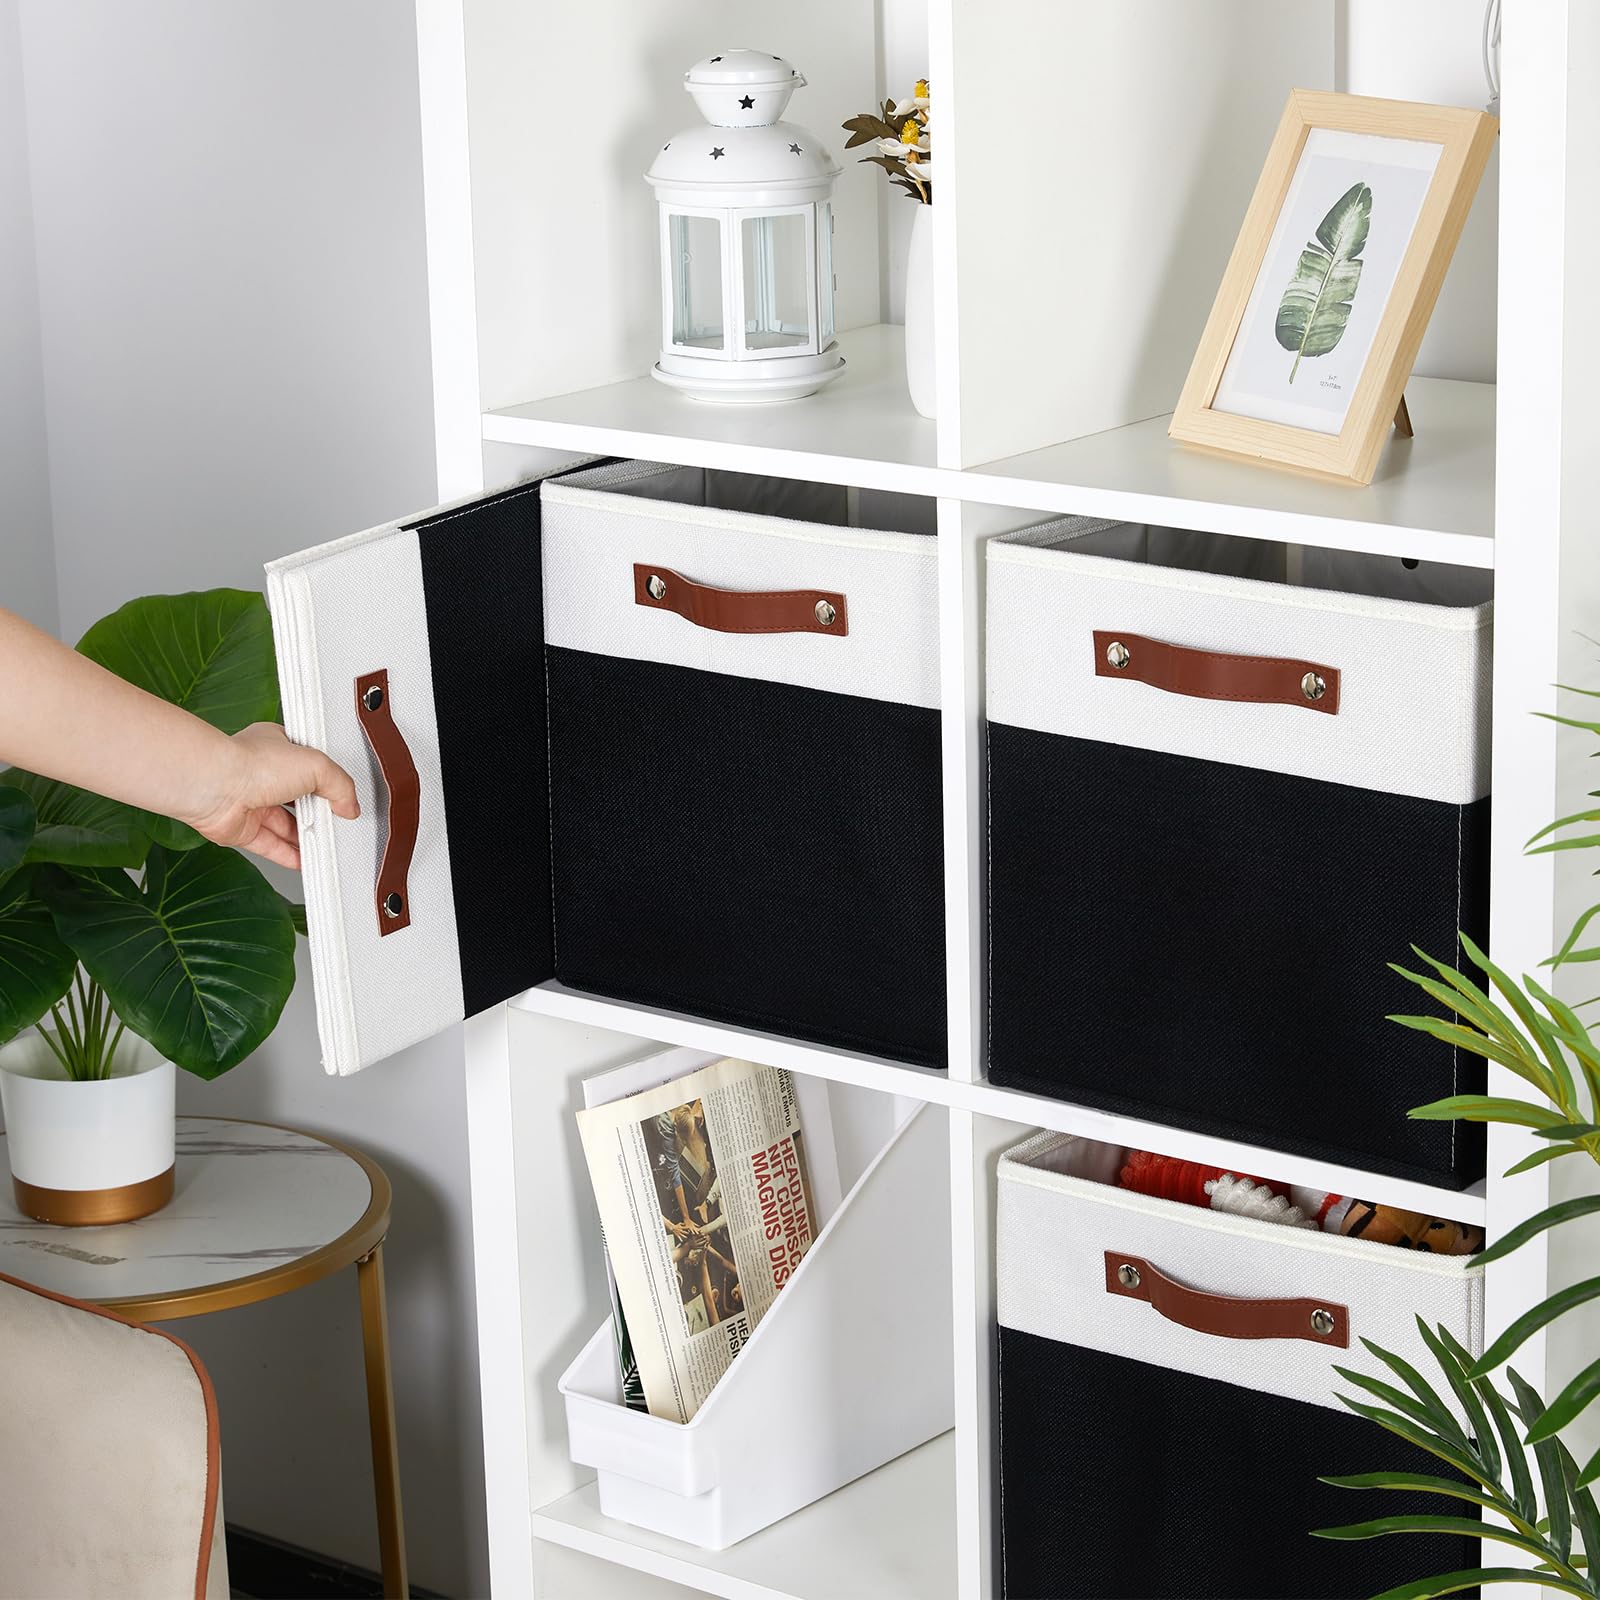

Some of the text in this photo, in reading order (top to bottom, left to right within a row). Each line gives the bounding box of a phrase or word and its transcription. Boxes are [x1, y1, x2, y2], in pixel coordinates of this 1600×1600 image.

[750, 1150, 780, 1241] MAGNIS
[767, 1143, 785, 1179] NIT
[776, 1185, 802, 1273] CUMSC
[778, 1136, 809, 1245] HEADLINE
